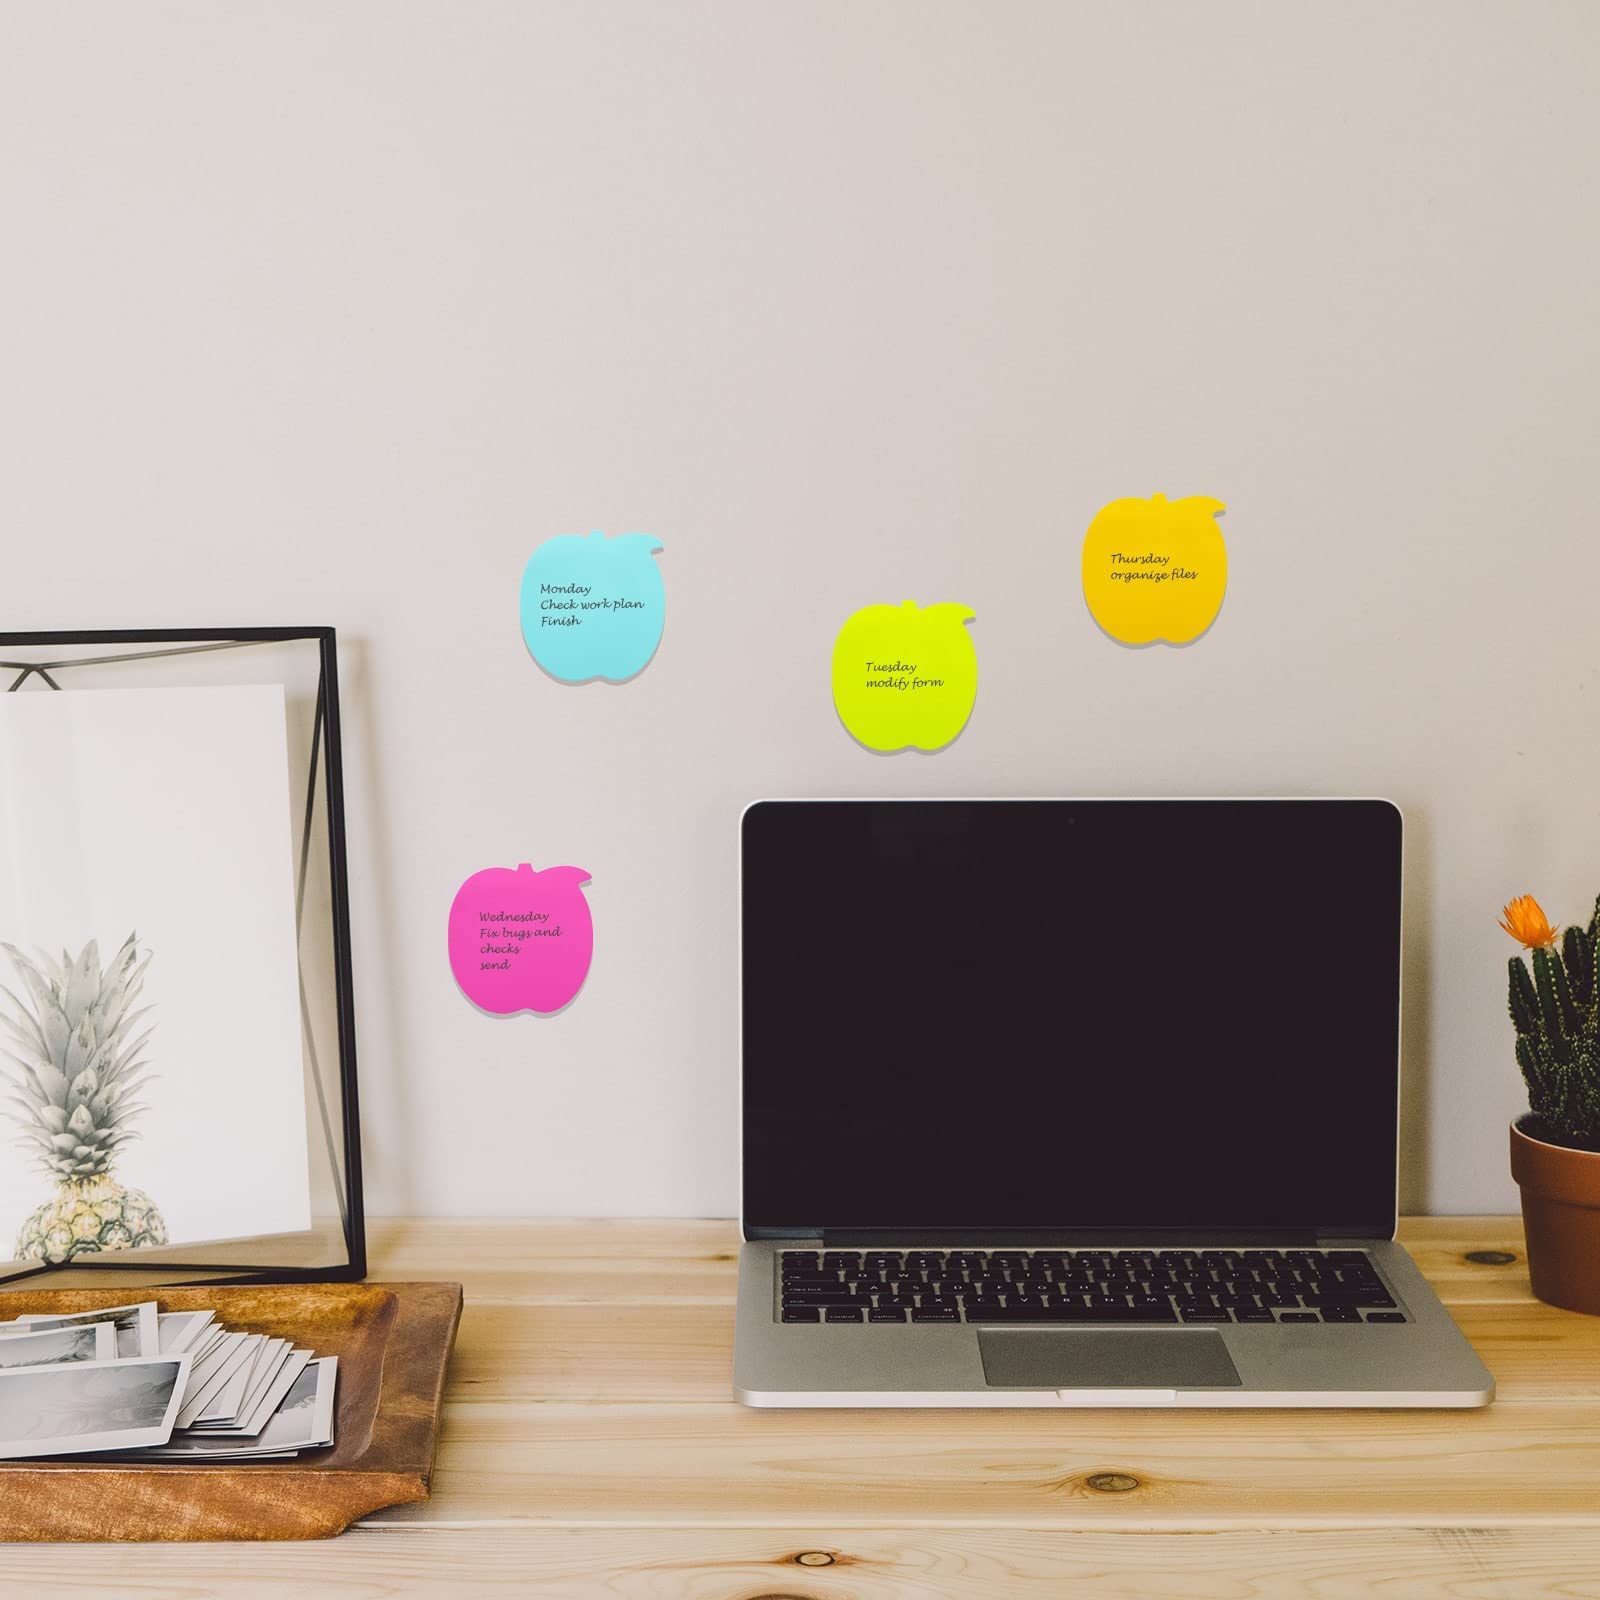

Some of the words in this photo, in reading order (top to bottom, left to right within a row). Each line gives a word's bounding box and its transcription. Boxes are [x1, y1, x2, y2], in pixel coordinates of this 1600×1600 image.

[1110, 552, 1170, 567] Thursday
[1110, 569, 1171, 584] organize
[1170, 567, 1199, 582] files
[540, 582, 592, 597] Monday
[540, 598, 580, 611] Check
[580, 597, 613, 611] work
[612, 597, 646, 613] plan
[540, 614, 583, 628] Finish
[865, 660, 918, 675] Tuesday
[865, 676, 910, 691] modify
[911, 676, 945, 691] form
[479, 911, 550, 924] Wednesday
[480, 927, 500, 940] Fix
[502, 926, 533, 941] bugs
[533, 925, 562, 938] and
[480, 942, 521, 955] checks
[480, 958, 512, 971] send
